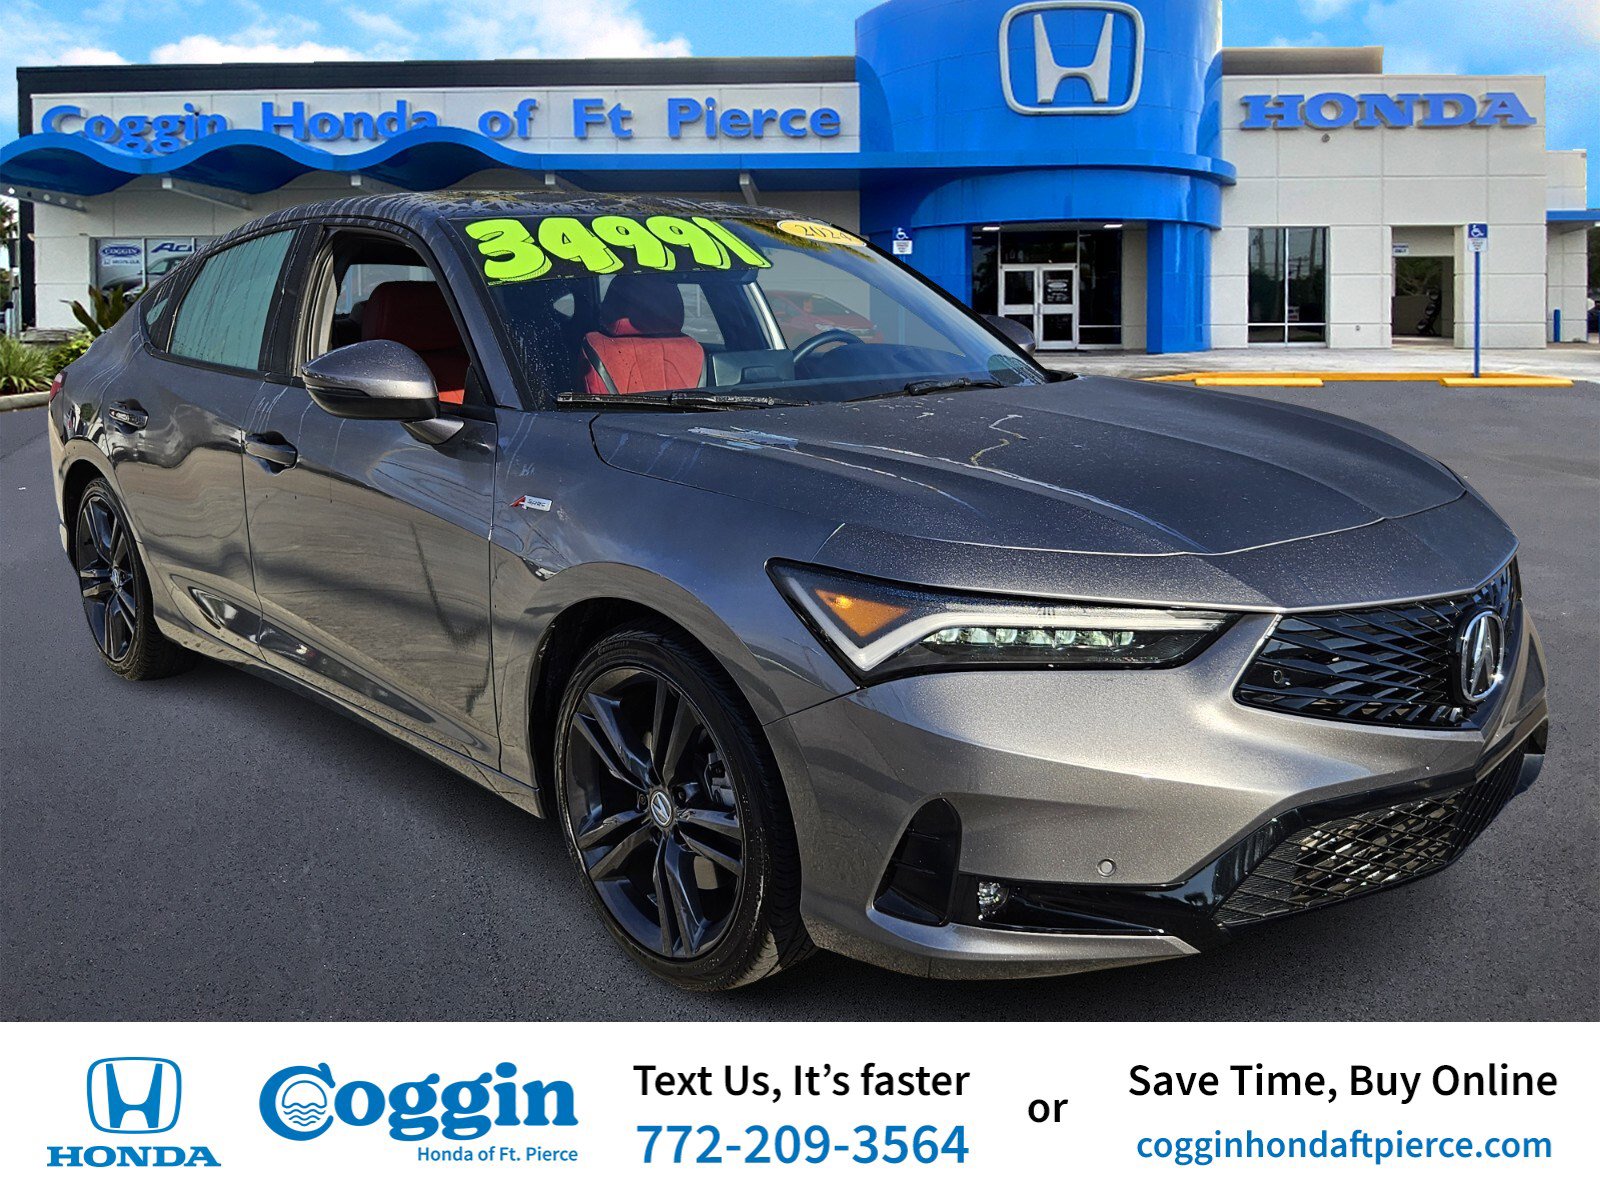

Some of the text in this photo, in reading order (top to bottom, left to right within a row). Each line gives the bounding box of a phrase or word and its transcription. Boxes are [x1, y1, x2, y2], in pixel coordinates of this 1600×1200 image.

[42, 97, 841, 154] Coggin Honda of Ft Pierce
[1241, 92, 1537, 129] HONDA
[465, 215, 771, 285] 34991
